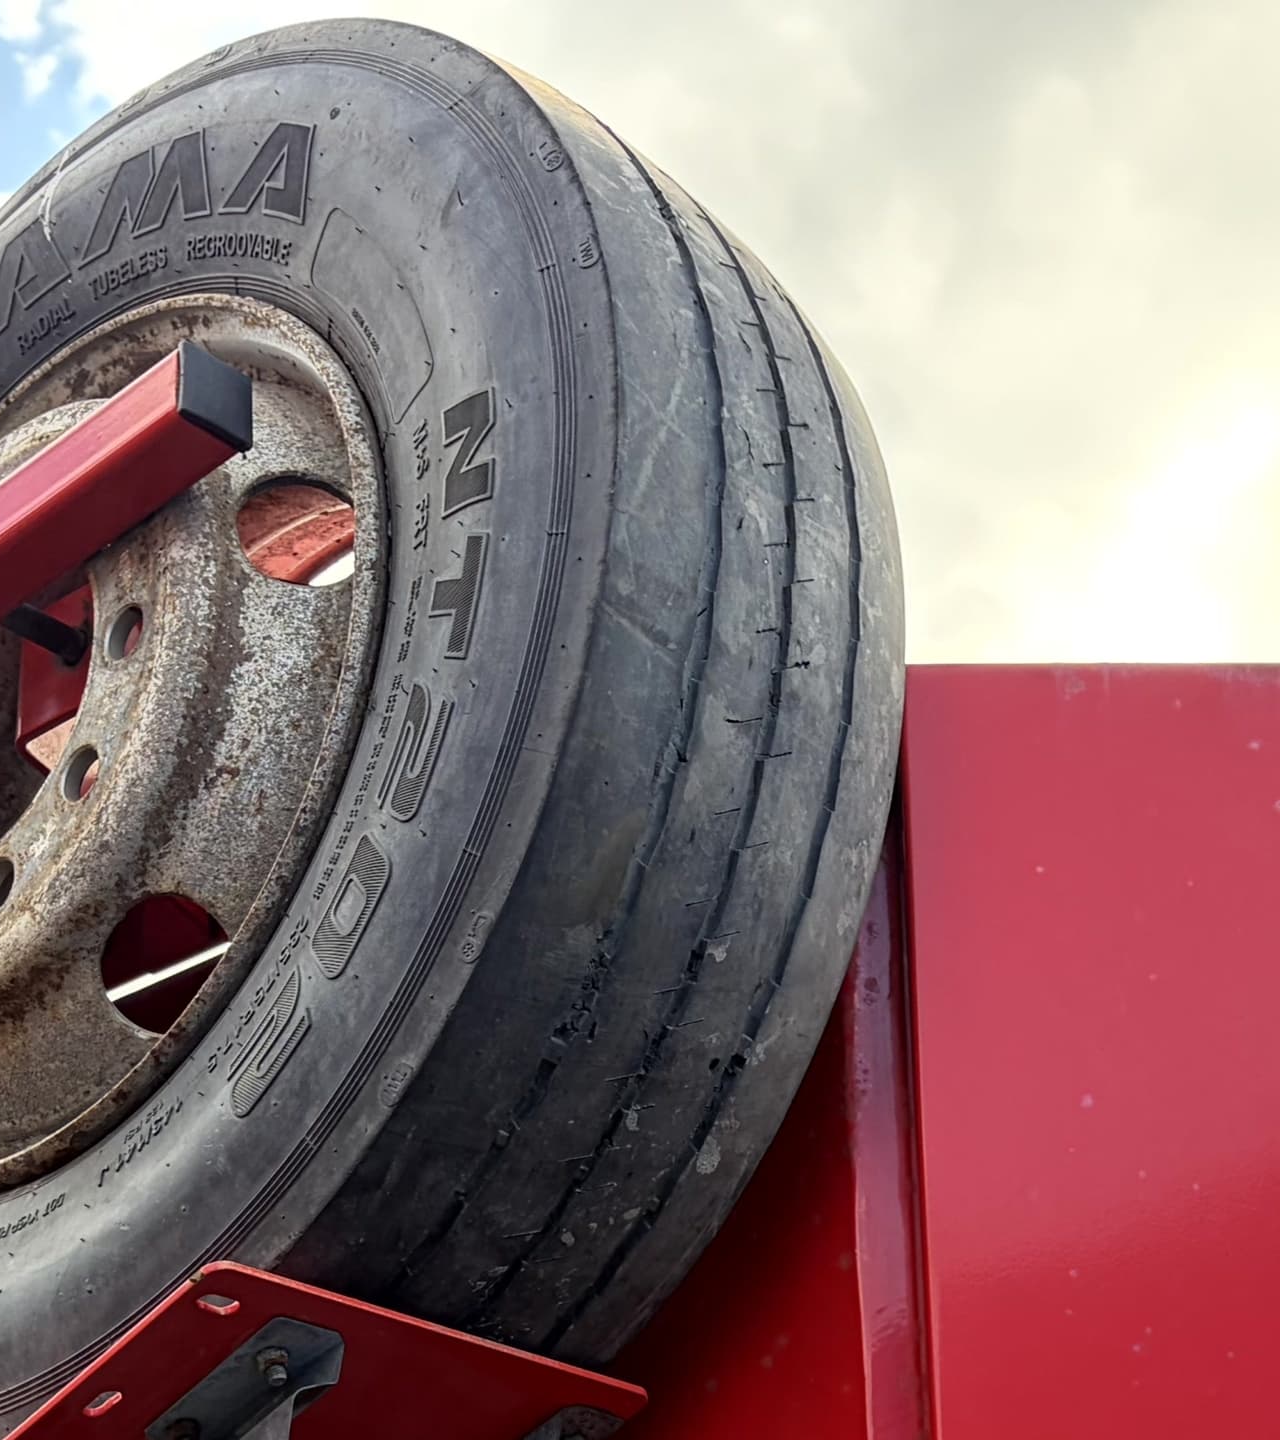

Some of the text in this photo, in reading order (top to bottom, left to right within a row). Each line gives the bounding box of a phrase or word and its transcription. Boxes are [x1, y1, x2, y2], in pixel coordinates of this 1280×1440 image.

[17, 300, 78, 355] RADIAL
[88, 246, 168, 298] TUBELESS
[185, 232, 292, 266] REGROOVABLE
